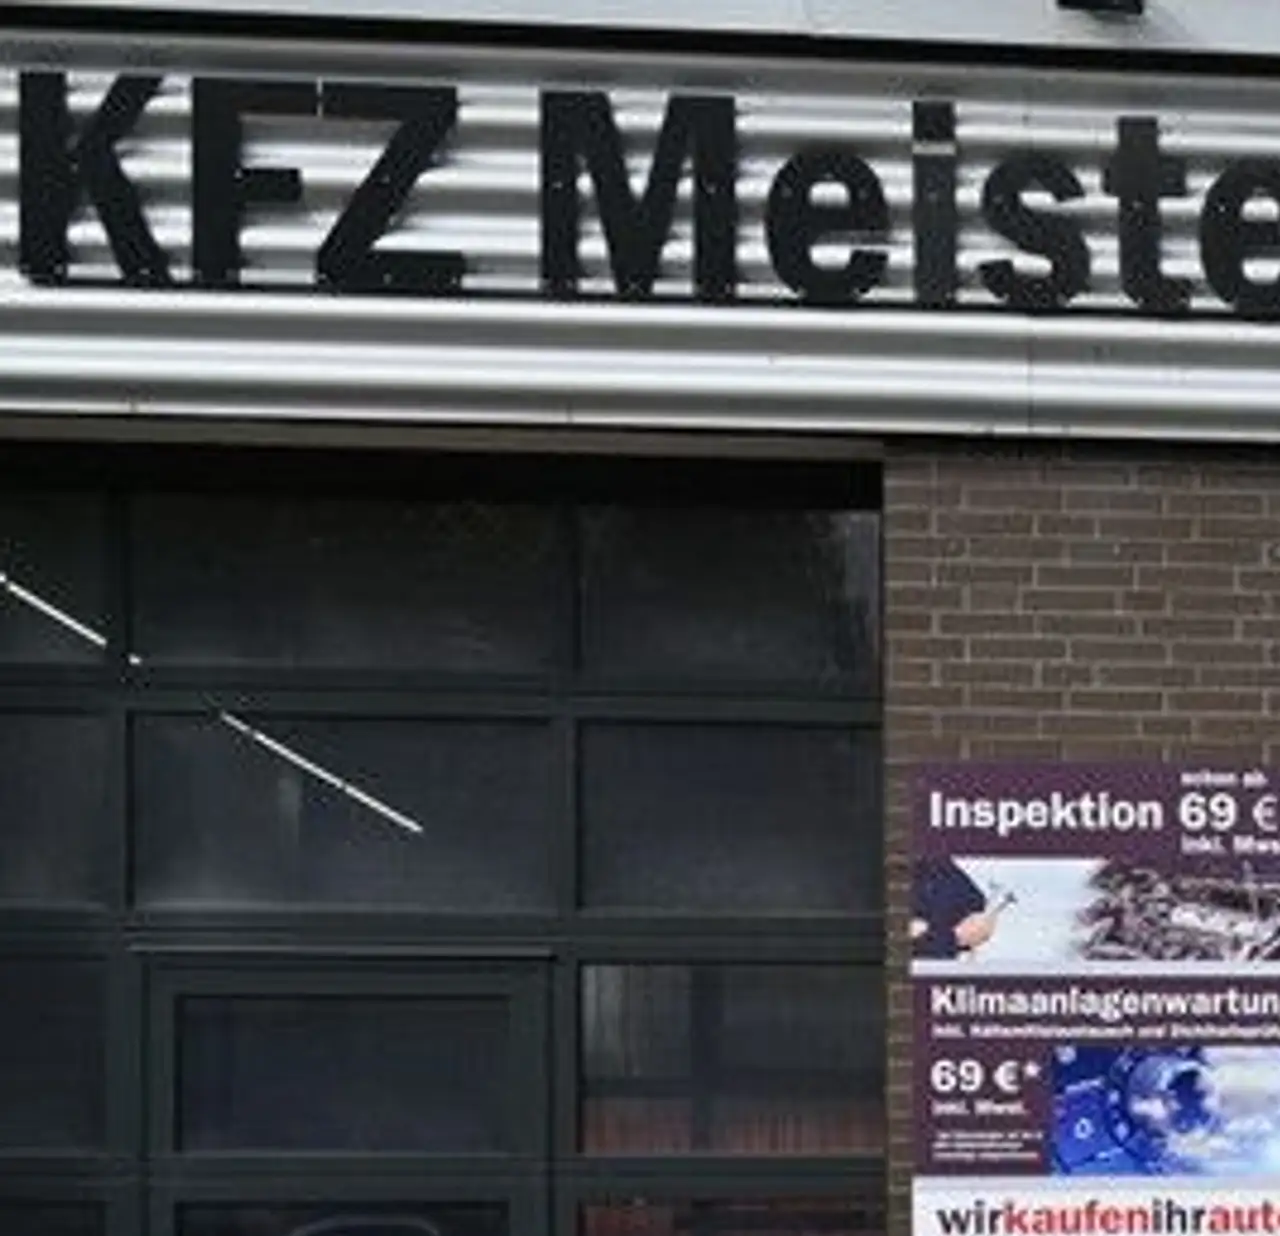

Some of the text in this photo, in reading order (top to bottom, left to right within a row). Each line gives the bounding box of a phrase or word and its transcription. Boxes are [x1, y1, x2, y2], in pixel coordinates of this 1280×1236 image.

[18, 70, 468, 288] KFZ
[930, 792, 1163, 837] Inspektion
[1179, 792, 1236, 831] 69
[931, 1059, 984, 1092] 69
